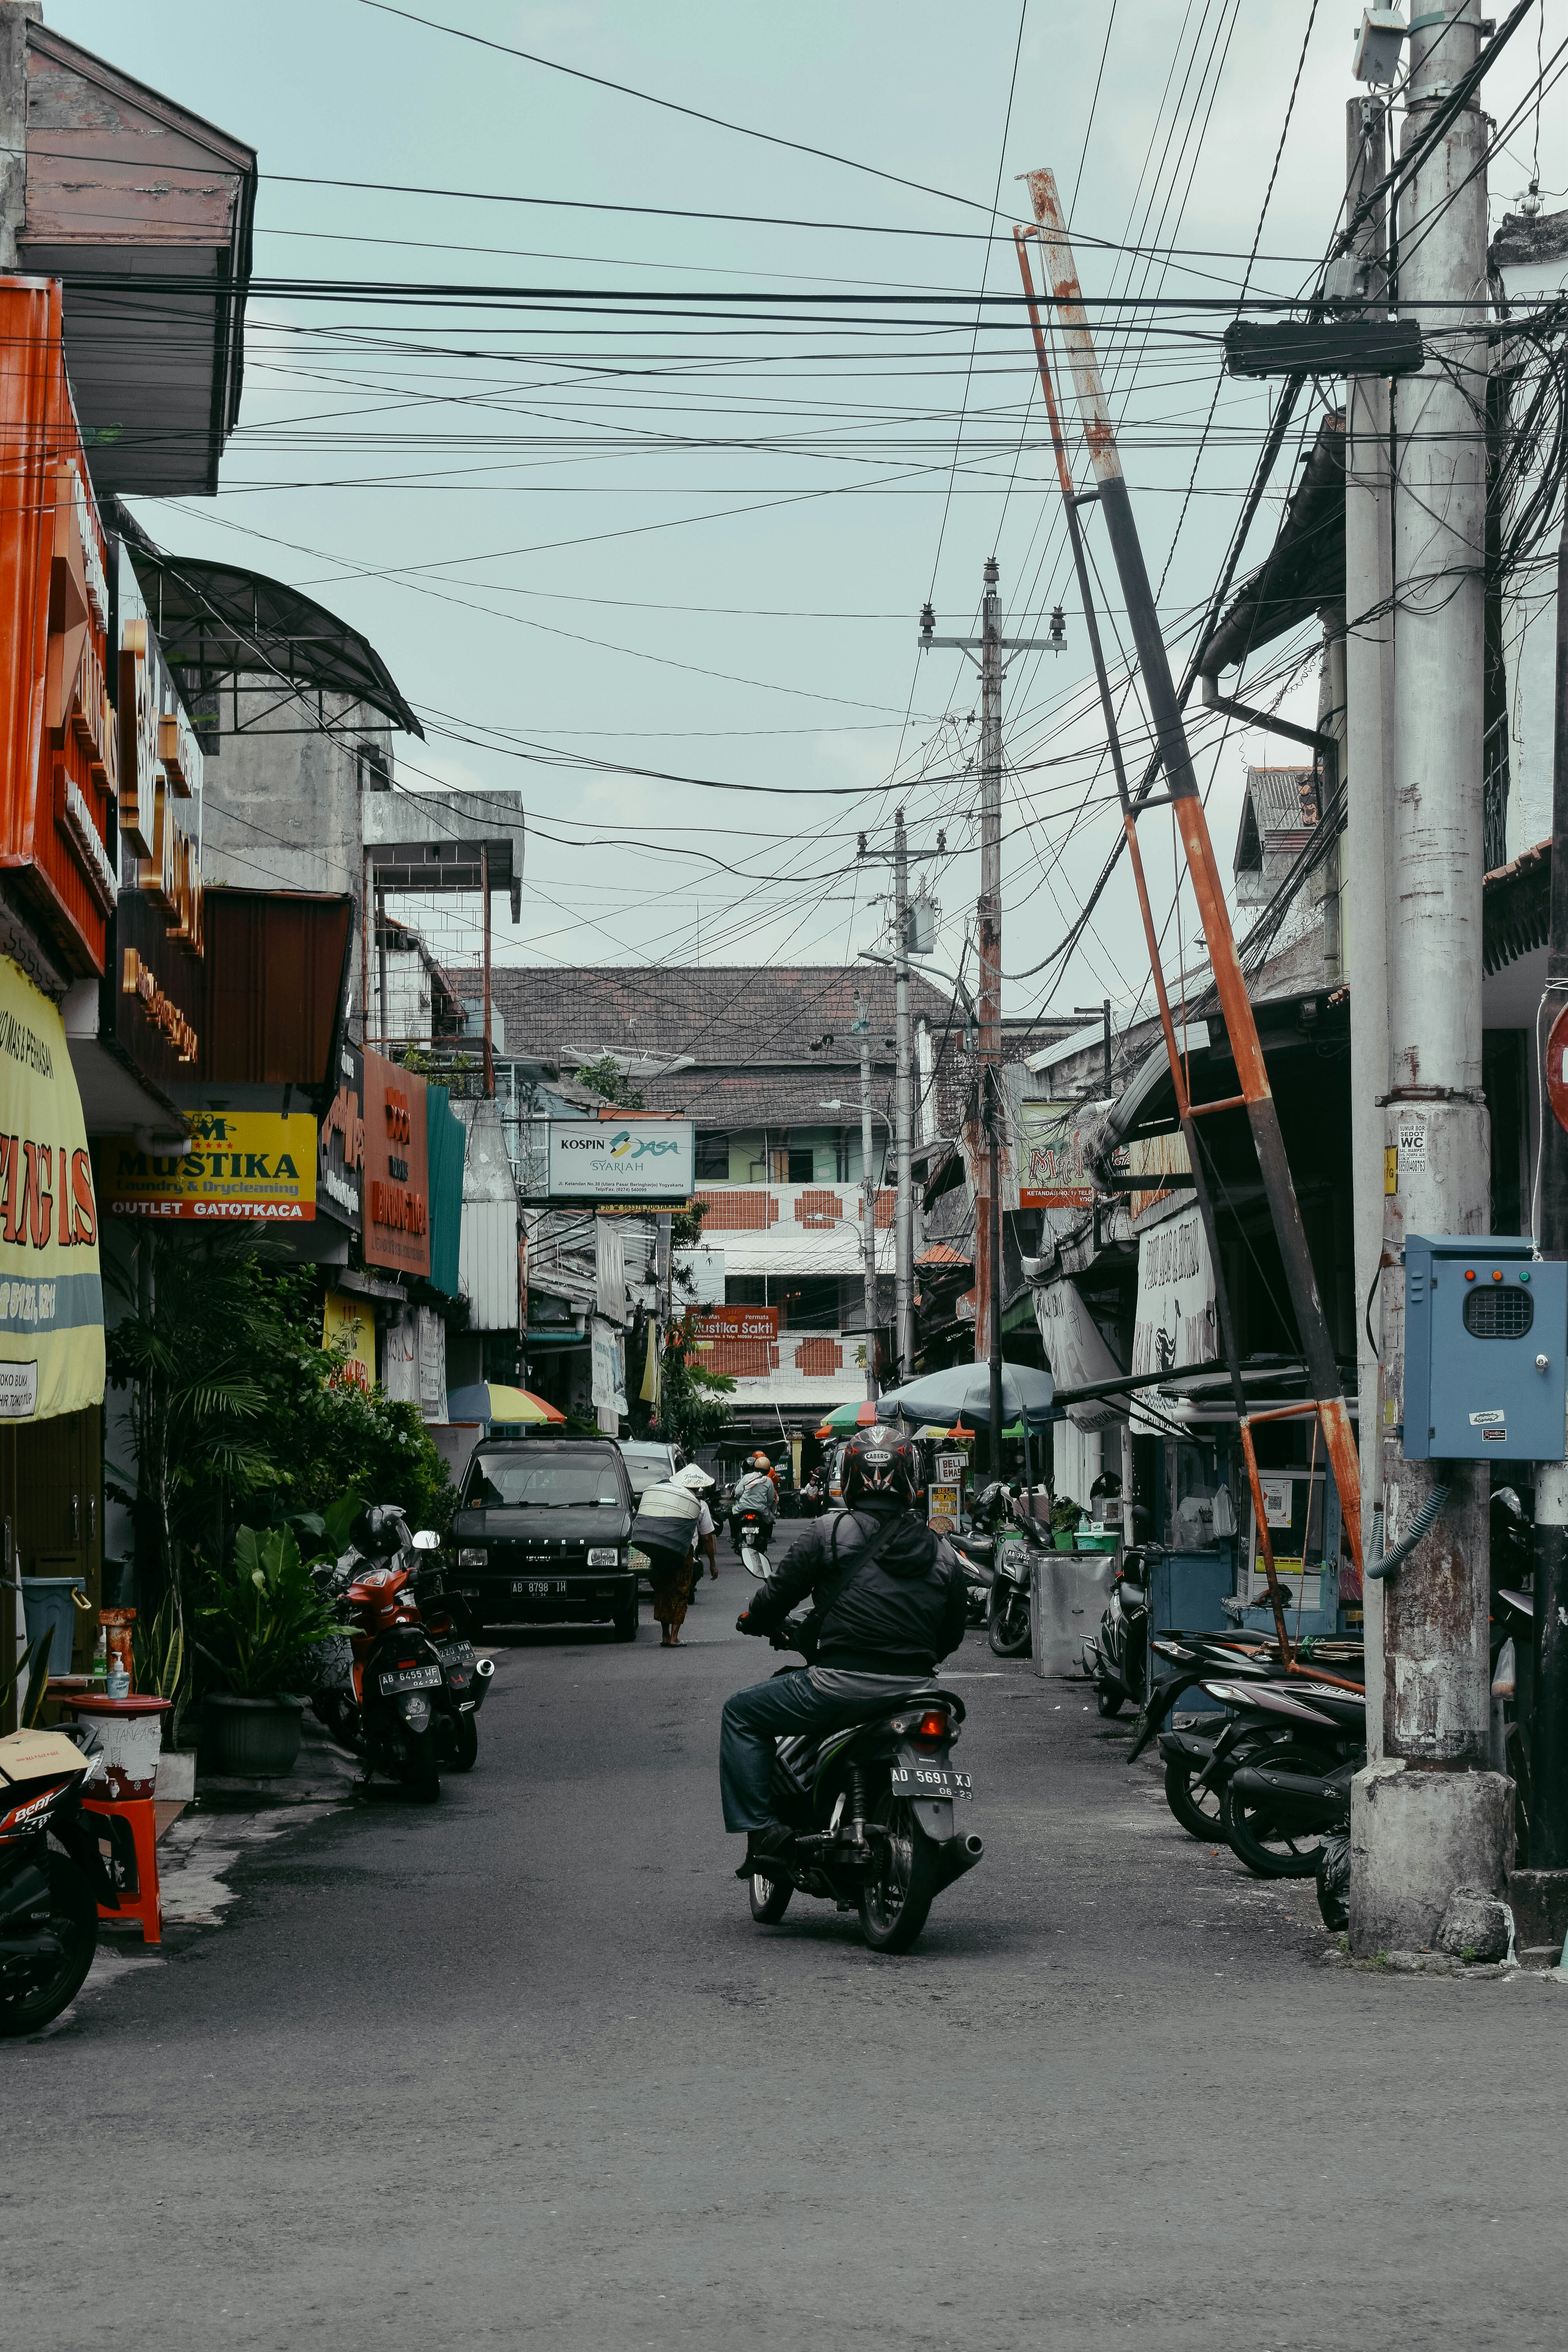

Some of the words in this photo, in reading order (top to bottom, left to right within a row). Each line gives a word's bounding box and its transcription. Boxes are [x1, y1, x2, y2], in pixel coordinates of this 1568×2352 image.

[5, 1014, 21, 1060] MAS
[21, 1025, 25, 1063] &
[561, 1140, 605, 1150] KOSPIN
[631, 1138, 682, 1159] JASA
[1401, 1137, 1424, 1148] WC
[116, 1151, 300, 1179] MUSTIKA
[590, 1159, 644, 1174] SYARIAH
[118, 1179, 183, 1194] Laundry
[187, 1181, 198, 1192] &
[203, 1181, 299, 1196] Drycleaning
[112, 1202, 183, 1214] OUTLET
[194, 1203, 303, 1217] GATOTKACA
[372, 1181, 408, 1230] BINTANG
[742, 1322, 773, 1334] Sakti
[0, 1374, 14, 1386] OKO
[15, 1375, 28, 1387] BUKA
[10, 1395, 23, 1407] TOKO
[513, 1583, 523, 1592] AB
[529, 1583, 548, 1592] 8798
[557, 1582, 566, 1592] IH
[457, 1643, 470, 1653] MN
[382, 1675, 394, 1684] AB
[399, 1670, 422, 1681] 6455
[425, 1668, 437, 1677] WF
[1308, 1682, 1366, 1701] VARI
[892, 1769, 908, 1782] AD
[916, 1771, 948, 1784] 5691
[955, 1774, 971, 1788] XJ
